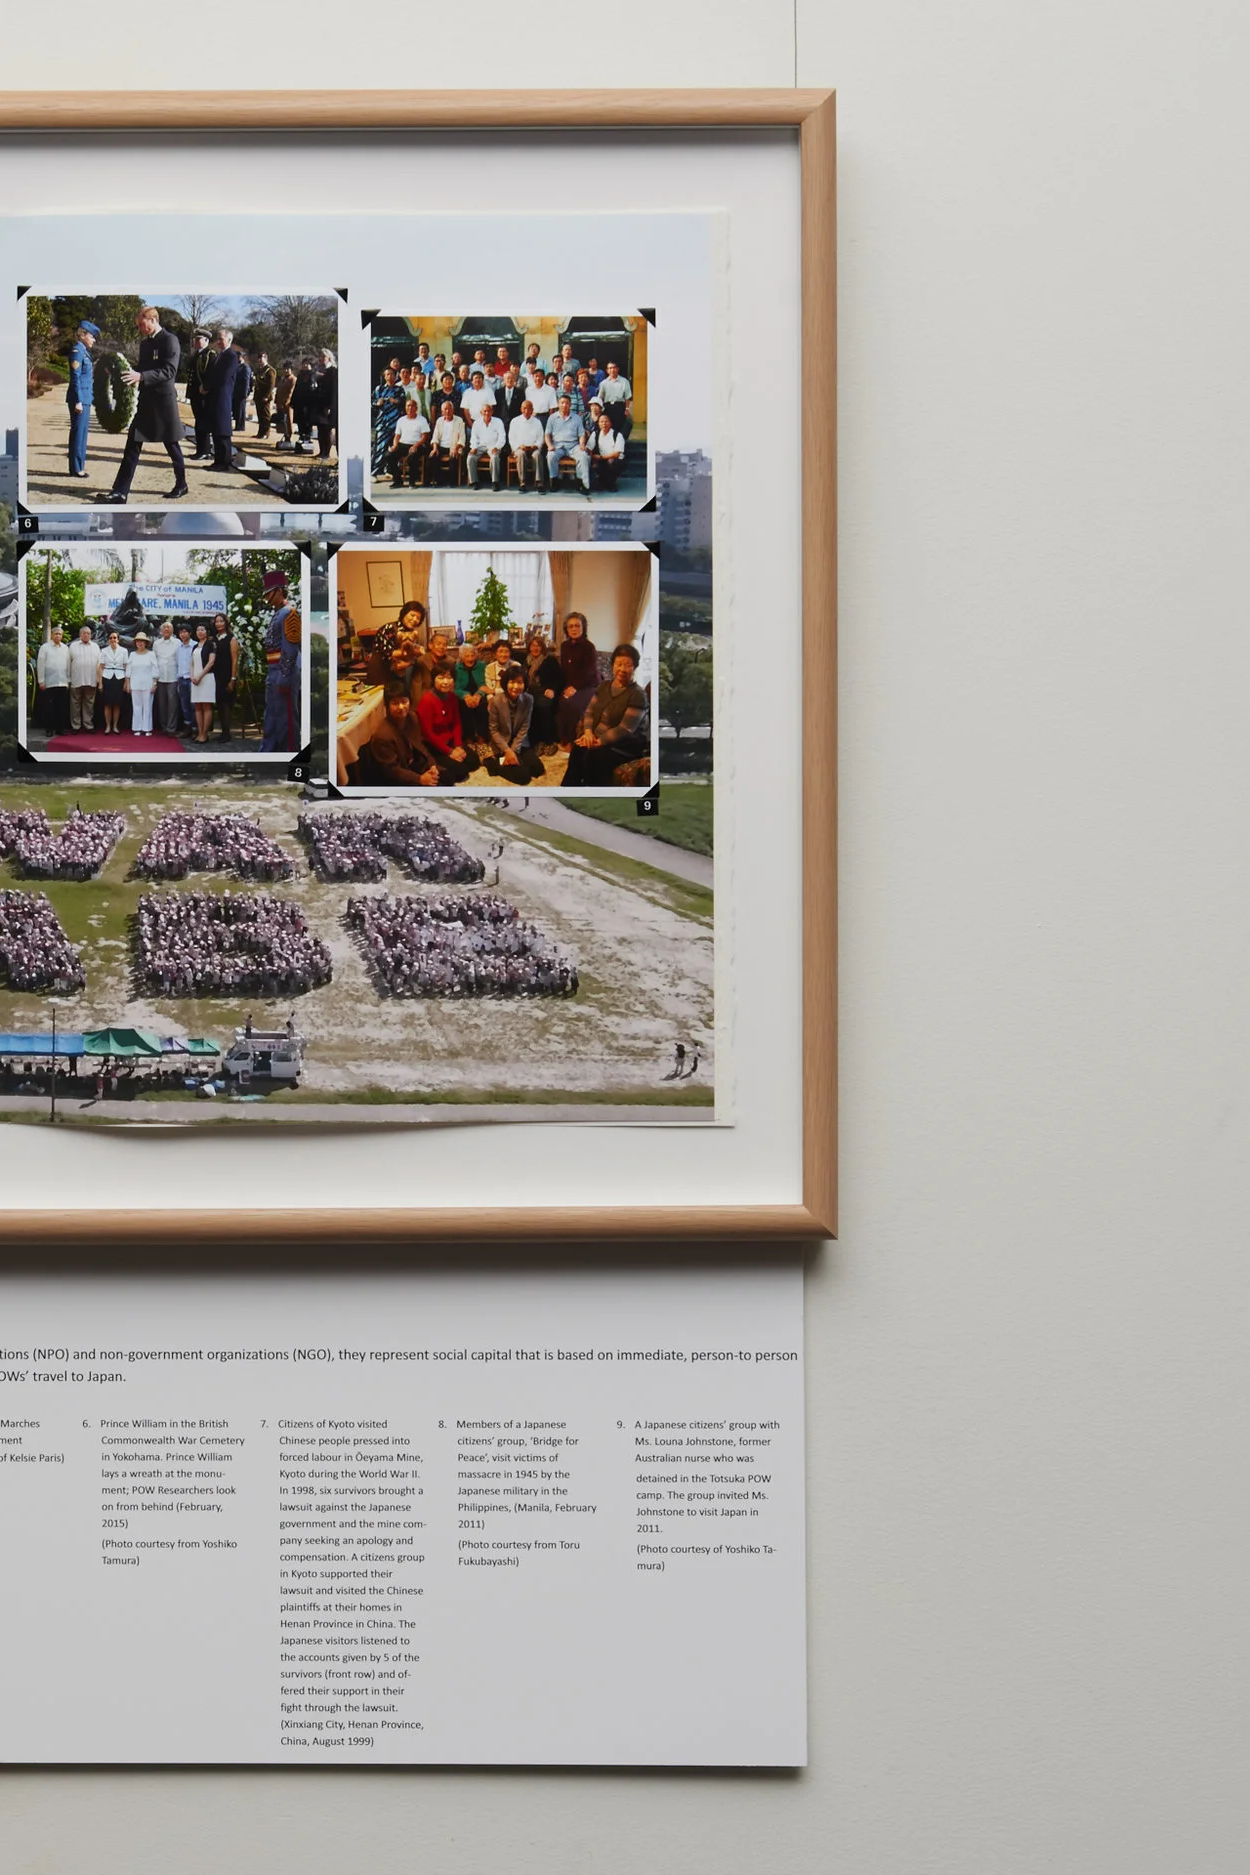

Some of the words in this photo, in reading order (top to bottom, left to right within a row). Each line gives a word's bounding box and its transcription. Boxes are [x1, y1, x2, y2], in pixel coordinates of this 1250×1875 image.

[24, 518, 32, 528] 6
[369, 516, 378, 527] 7
[174, 586, 204, 594] MANILA
[163, 598, 199, 610] MANILA
[202, 600, 225, 611] 1945
[293, 767, 302, 778] 8
[643, 800, 652, 811] 9
[32, 1347, 70, 1363] (NPO)
[72, 1347, 96, 1360] and
[99, 1349, 204, 1363] non-government
[206, 1348, 290, 1363] organizations
[292, 1347, 335, 1363] (NGO),
[338, 1348, 367, 1363] they
[369, 1349, 430, 1363] represent
[432, 1348, 468, 1361] social
[470, 1348, 512, 1363] capital
[515, 1348, 541, 1361] that
[544, 1348, 554, 1361] is
[557, 1348, 594, 1361] based
[597, 1351, 614, 1361] on
[617, 1348, 688, 1363] immediate,
[691, 1350, 752, 1364] person-to
[755, 1351, 798, 1364] person
[32, 1369, 68, 1382] travel
[70, 1371, 84, 1382] to
[86, 1370, 127, 1385] Japan.
[0, 1418, 41, 1429] Marches
[82, 1419, 91, 1429] 6.
[100, 1419, 130, 1429] Prince
[131, 1419, 167, 1429] William
[169, 1419, 179, 1429] in
[180, 1419, 197, 1429] the
[198, 1419, 229, 1429] British
[260, 1419, 269, 1429] 7.
[277, 1419, 315, 1429] Citizens
[315, 1418, 327, 1429] of
[328, 1419, 356, 1431] Kyoto
[356, 1419, 388, 1429] visited
[437, 1419, 447, 1429] 8.
[456, 1419, 502, 1429] Members
[503, 1419, 514, 1429] of
[515, 1421, 522, 1429] a
[523, 1420, 567, 1431] Japanese
[616, 1420, 626, 1430] 9.
[634, 1420, 642, 1429] A
[643, 1420, 687, 1431] Japanese
[728, 1422, 757, 1432] group
[758, 1420, 781, 1430] with
[101, 1555, 140, 1567] Tamura)
[458, 1556, 520, 1568] Fukubayashi)
[636, 1560, 665, 1573] mura)
[280, 1736, 310, 1747] China,
[311, 1736, 345, 1748] August
[347, 1736, 375, 1748] 1999)
